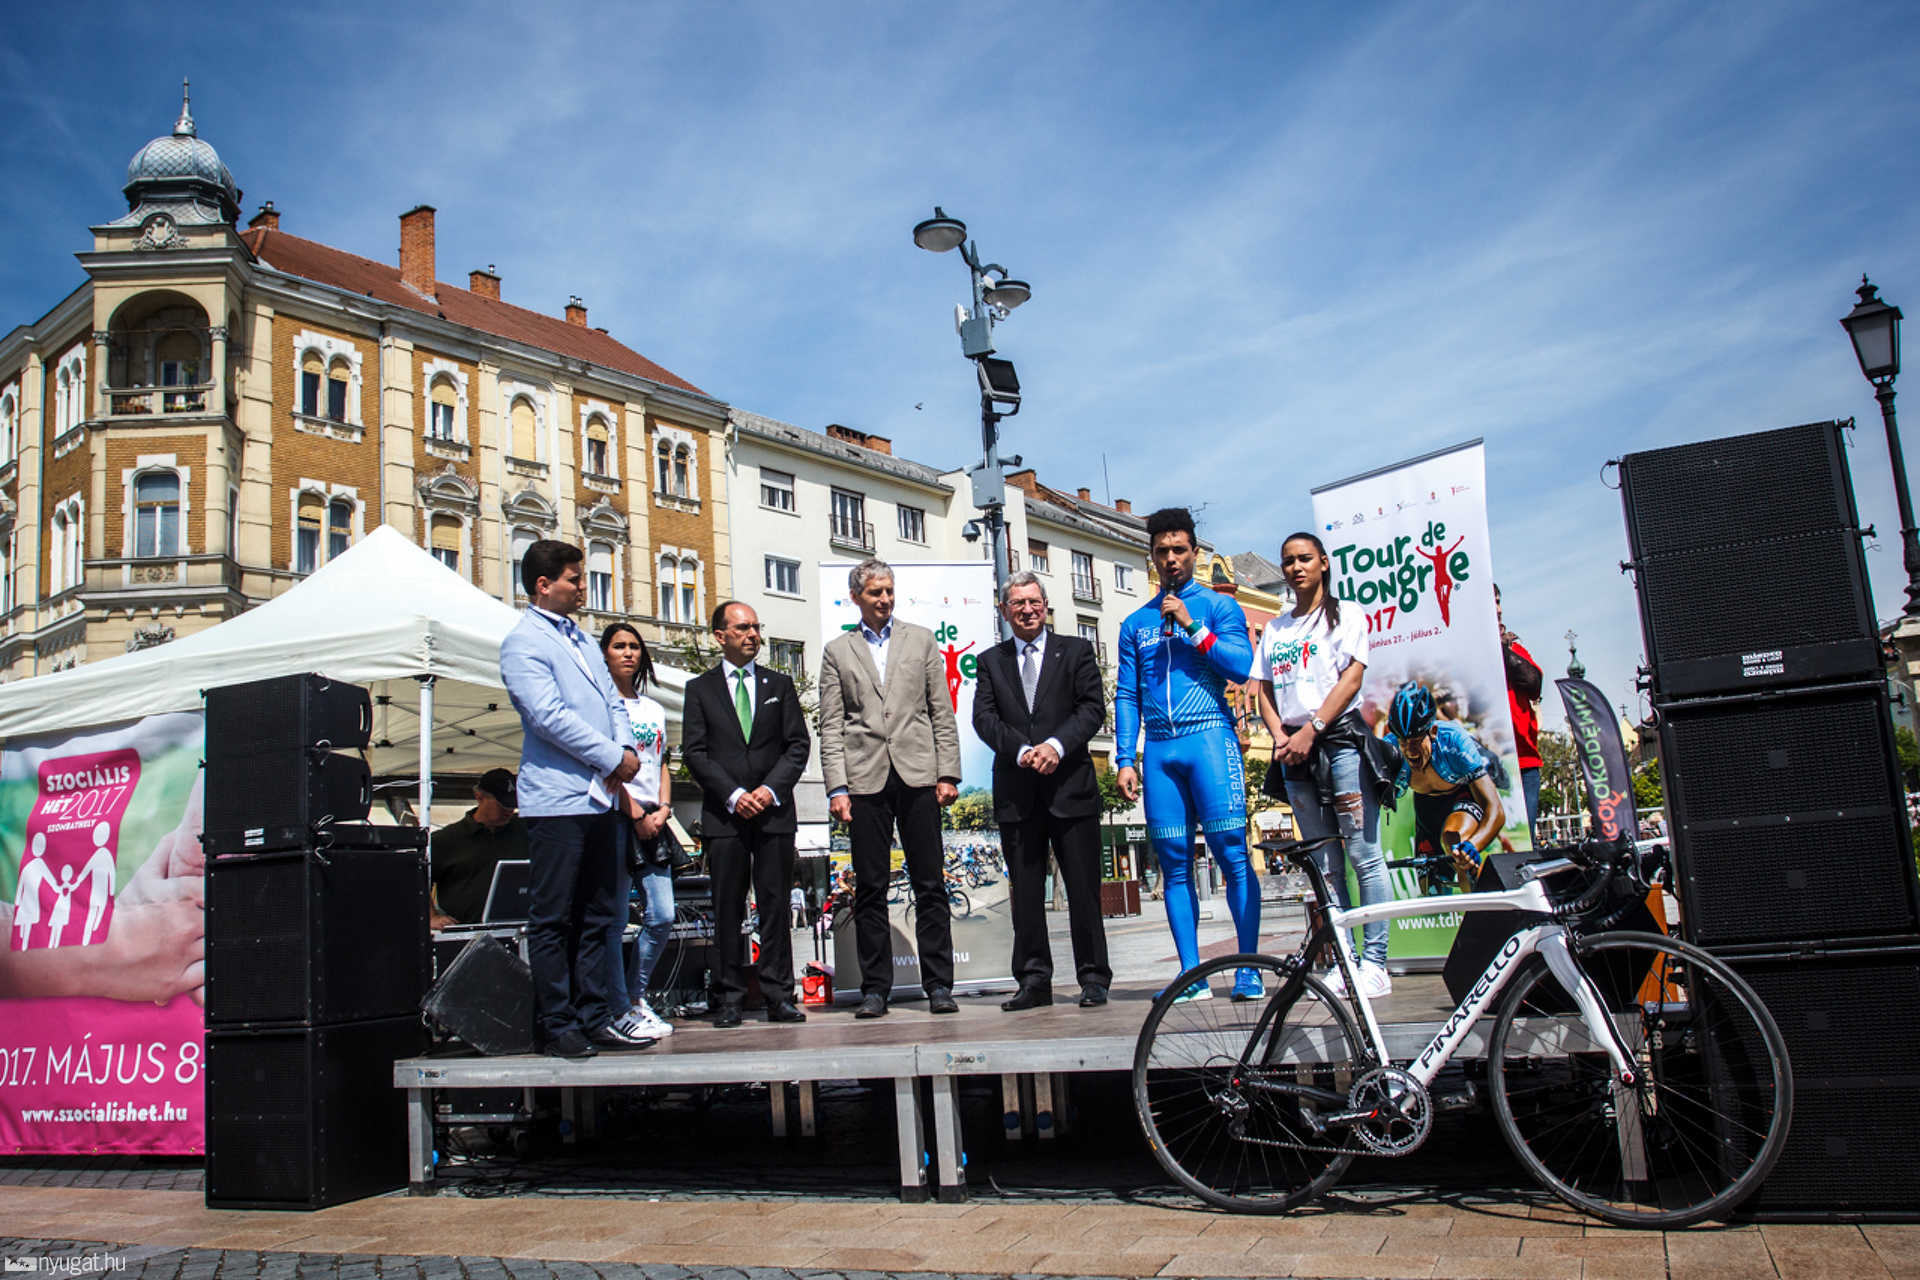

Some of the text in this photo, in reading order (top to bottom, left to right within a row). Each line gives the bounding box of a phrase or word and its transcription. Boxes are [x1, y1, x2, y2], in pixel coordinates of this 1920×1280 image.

[1332, 520, 1446, 575] Tour de
[935, 621, 958, 643] de
[1365, 605, 1397, 634] 17
[1369, 638, 1392, 651] június
[1411, 629, 1433, 642] július
[1434, 626, 1442, 636] 2.
[46, 764, 131, 792] SZOCIÁLIS
[40, 785, 127, 820] HÉT 2017
[1420, 937, 1520, 1069] PINARELLO
[45, 1032, 167, 1085] MÁJUS
[21, 1101, 188, 1123] www.szocialishet.hu
